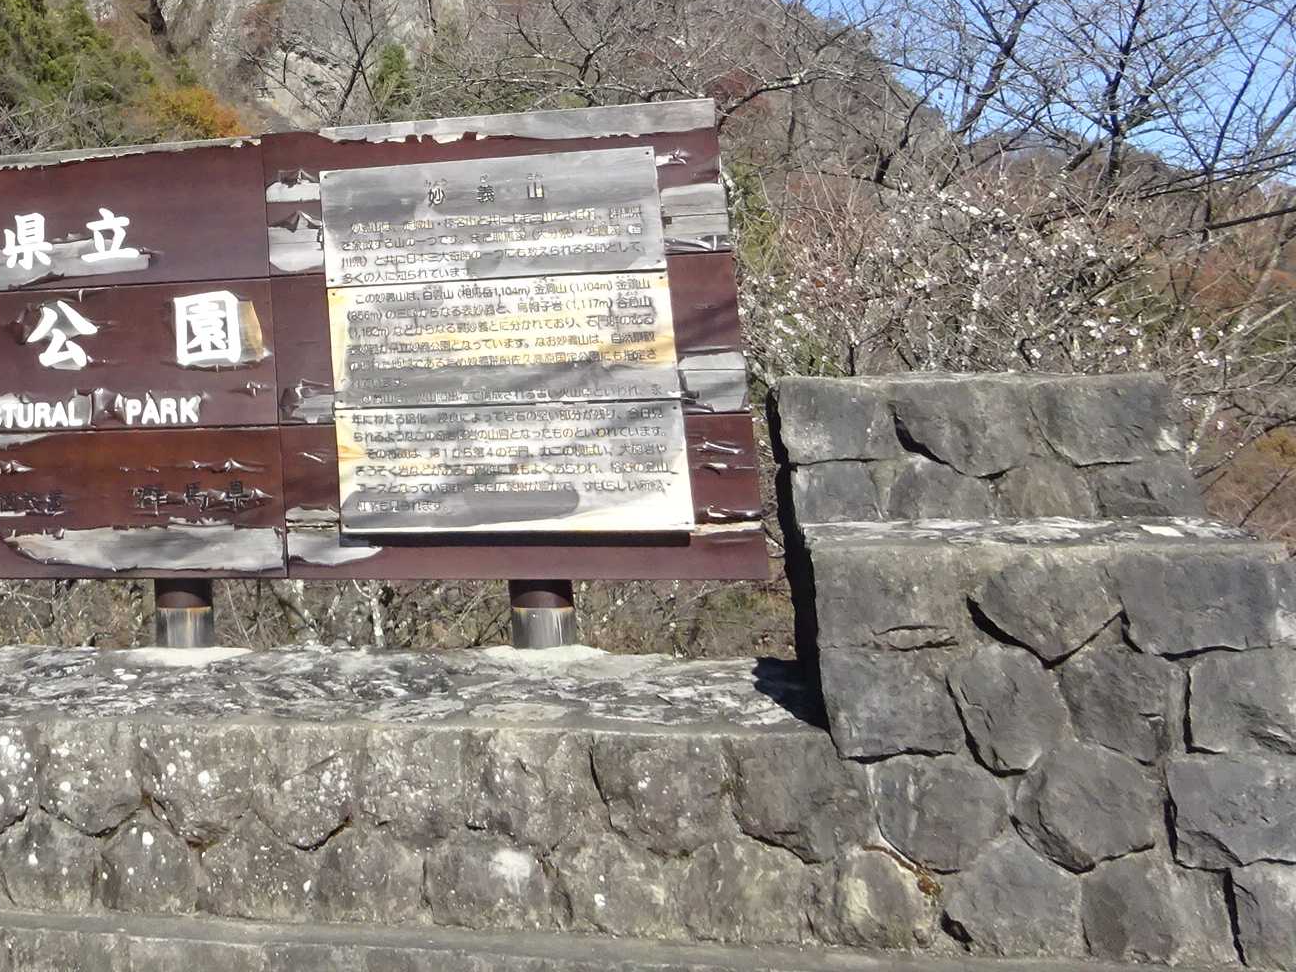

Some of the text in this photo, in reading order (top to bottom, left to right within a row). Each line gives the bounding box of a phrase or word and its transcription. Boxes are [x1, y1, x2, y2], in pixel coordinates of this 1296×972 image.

[427, 181, 545, 206] 妙義山
[124, 395, 201, 425] PARK
